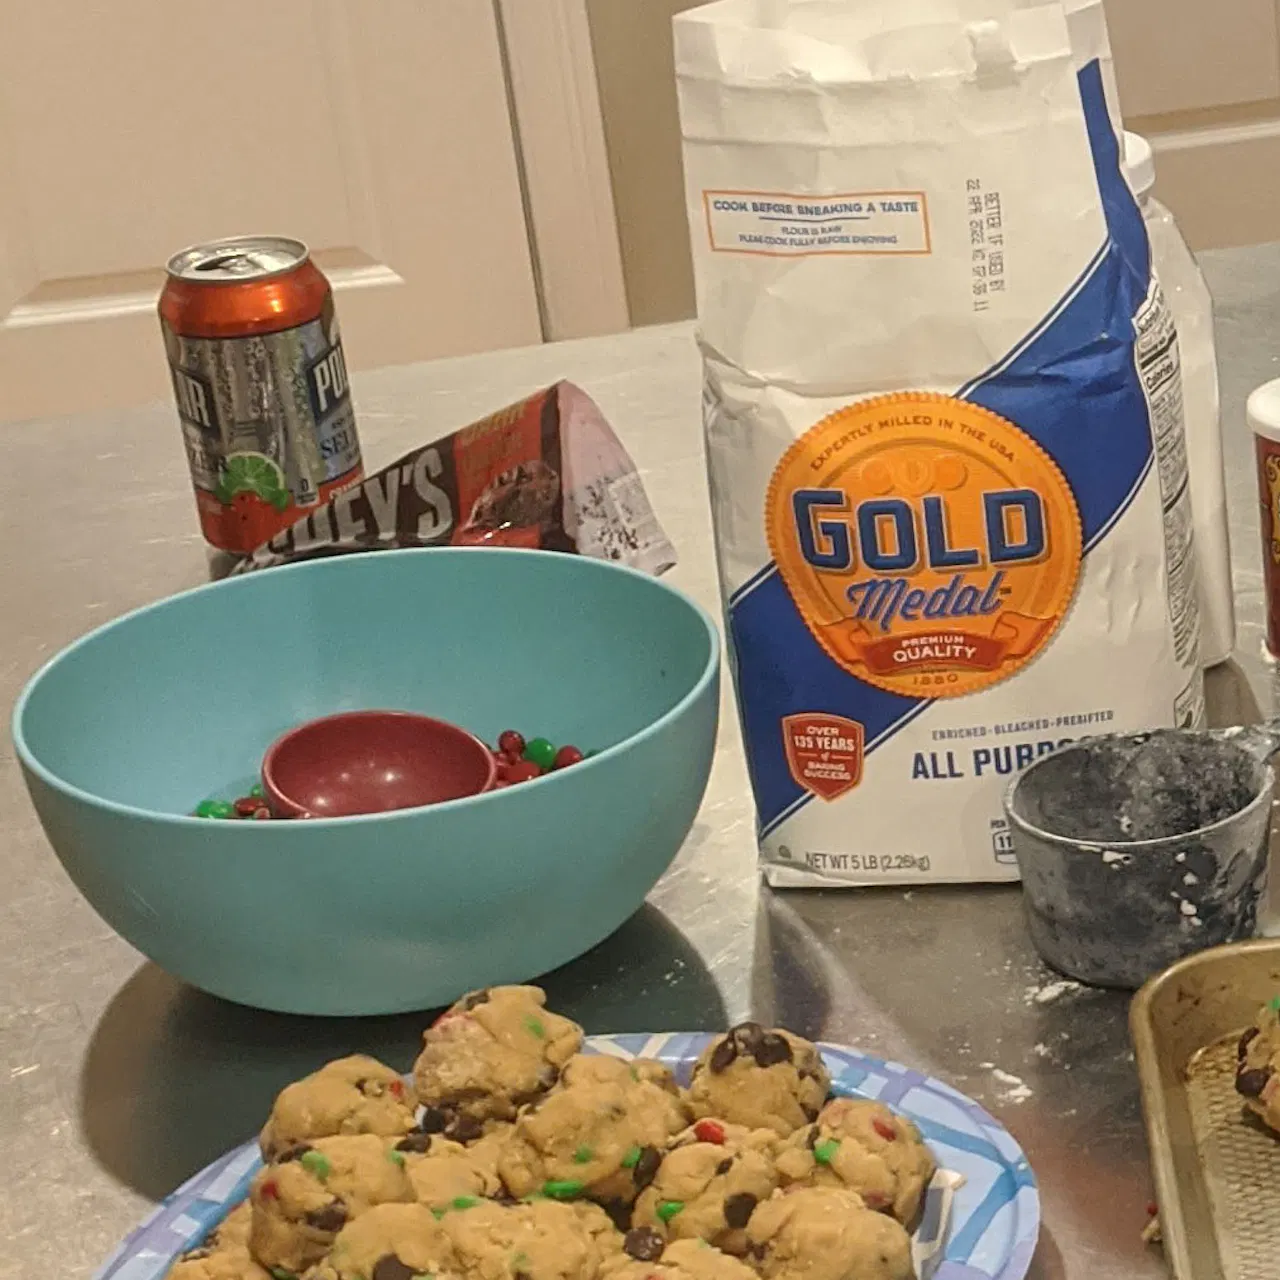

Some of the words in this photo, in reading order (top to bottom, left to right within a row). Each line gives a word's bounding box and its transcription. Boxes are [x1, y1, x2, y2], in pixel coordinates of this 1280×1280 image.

[713, 201, 748, 211] COOK
[752, 202, 793, 214] BEFORE
[797, 203, 862, 216] SNEAKING
[867, 202, 876, 213] A
[880, 201, 918, 212] TASTE
[810, 422, 873, 471] EXPERTLY
[879, 415, 932, 431] MILLED
[938, 417, 953, 430] IN
[959, 423, 986, 442] THE
[989, 438, 1016, 462] USA
[792, 487, 1047, 572] GOLD
[847, 570, 1006, 633] Medal
[901, 635, 964, 647] PREMIUM
[893, 645, 977, 662] QUALITY
[913, 673, 958, 685] 1880
[806, 726, 839, 736] OVER
[994, 719, 1050, 735] BLEACHED
[1056, 710, 1114, 726] PRESIFTED
[794, 736, 813, 748] 135
[816, 736, 855, 751] YEARS
[912, 751, 964, 780] ALL
[805, 852, 827, 869] NET
[830, 853, 848, 869] WT
[852, 854, 860, 869] 5
[863, 854, 878, 869] LB
